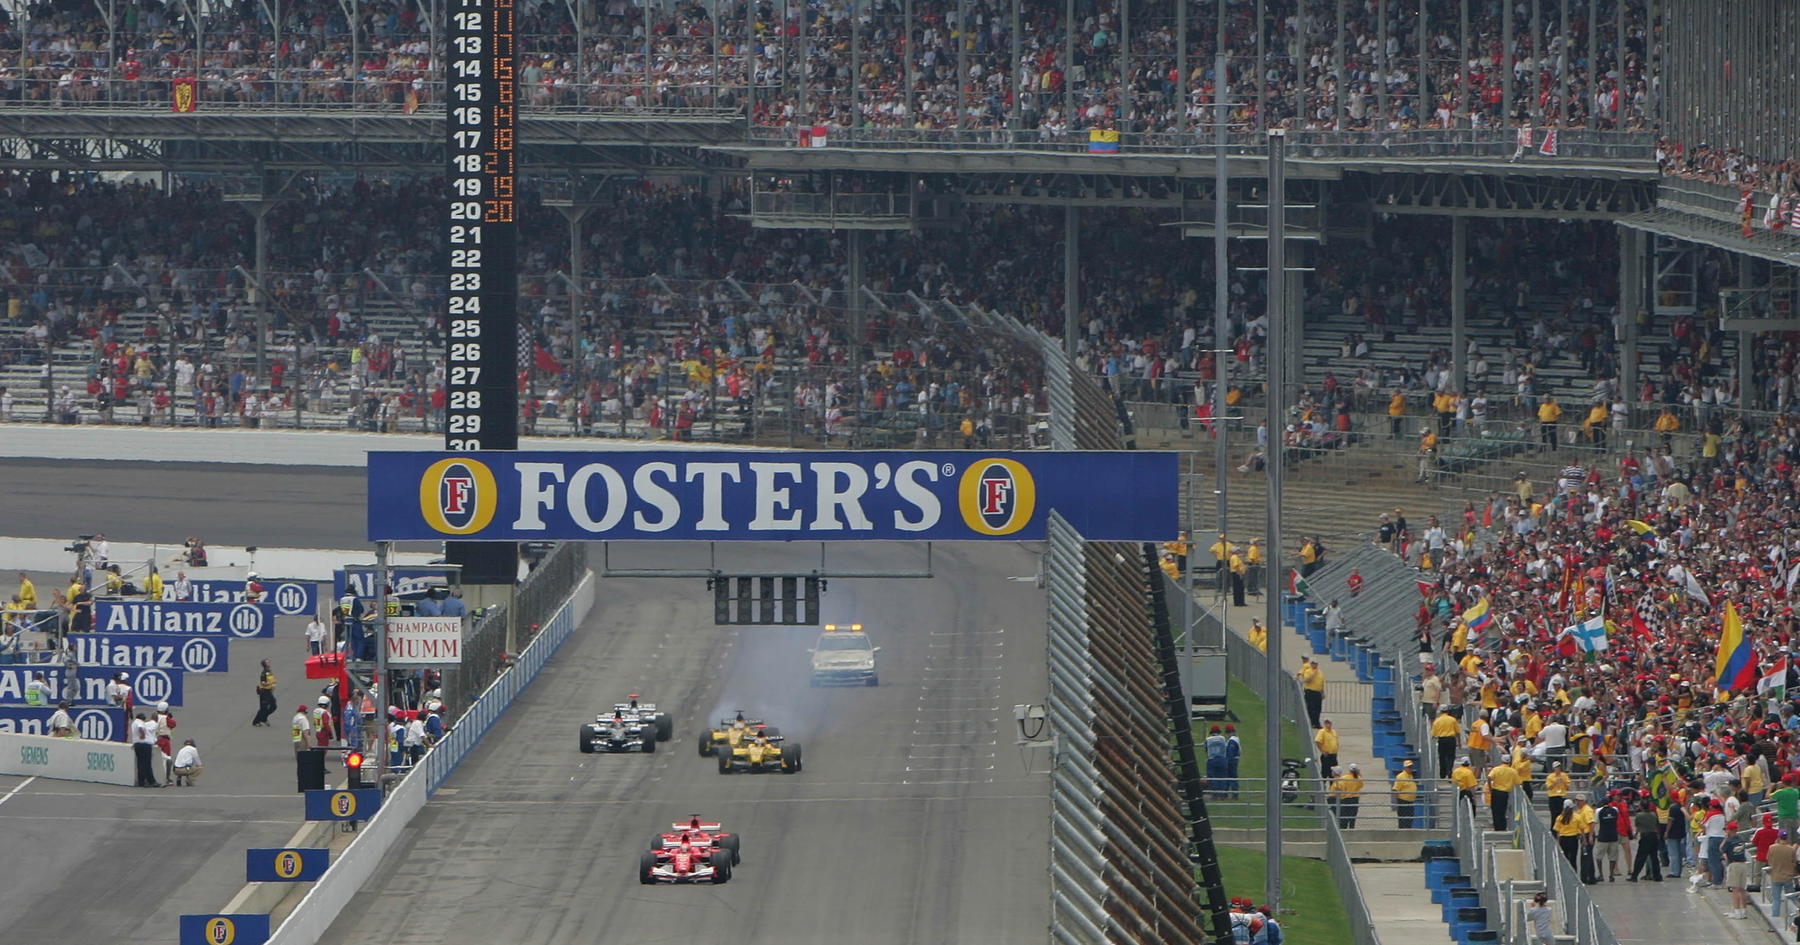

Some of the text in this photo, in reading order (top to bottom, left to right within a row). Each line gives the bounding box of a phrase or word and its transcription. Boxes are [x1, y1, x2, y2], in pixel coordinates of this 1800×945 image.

[454, 11, 513, 31] 12 11
[454, 34, 513, 54] 13 17
[453, 58, 513, 79] 14 15
[454, 82, 513, 103] 15 8
[454, 106, 513, 126] 16 14
[453, 129, 513, 150] 17 18
[453, 153, 513, 173] 18 21
[453, 177, 513, 197] 19 19
[451, 201, 513, 222] 20 20
[451, 226, 480, 243] 21
[452, 250, 480, 267] 22
[451, 274, 480, 290] 23
[450, 297, 480, 313] 24
[451, 320, 480, 337] 25
[451, 344, 480, 360] 26
[451, 367, 480, 384] 27
[451, 391, 480, 408] 28
[450, 415, 480, 433] 29
[450, 440, 480, 450] 30
[162, 584, 269, 602] Alian
[106, 604, 222, 633] Allianz
[388, 621, 458, 632] CHAMPAGNE
[387, 637, 459, 658] MUMM
[0, 670, 106, 700] Alian
[21, 746, 49, 765] SIEMENS
[87, 752, 115, 771] SIEMENS
